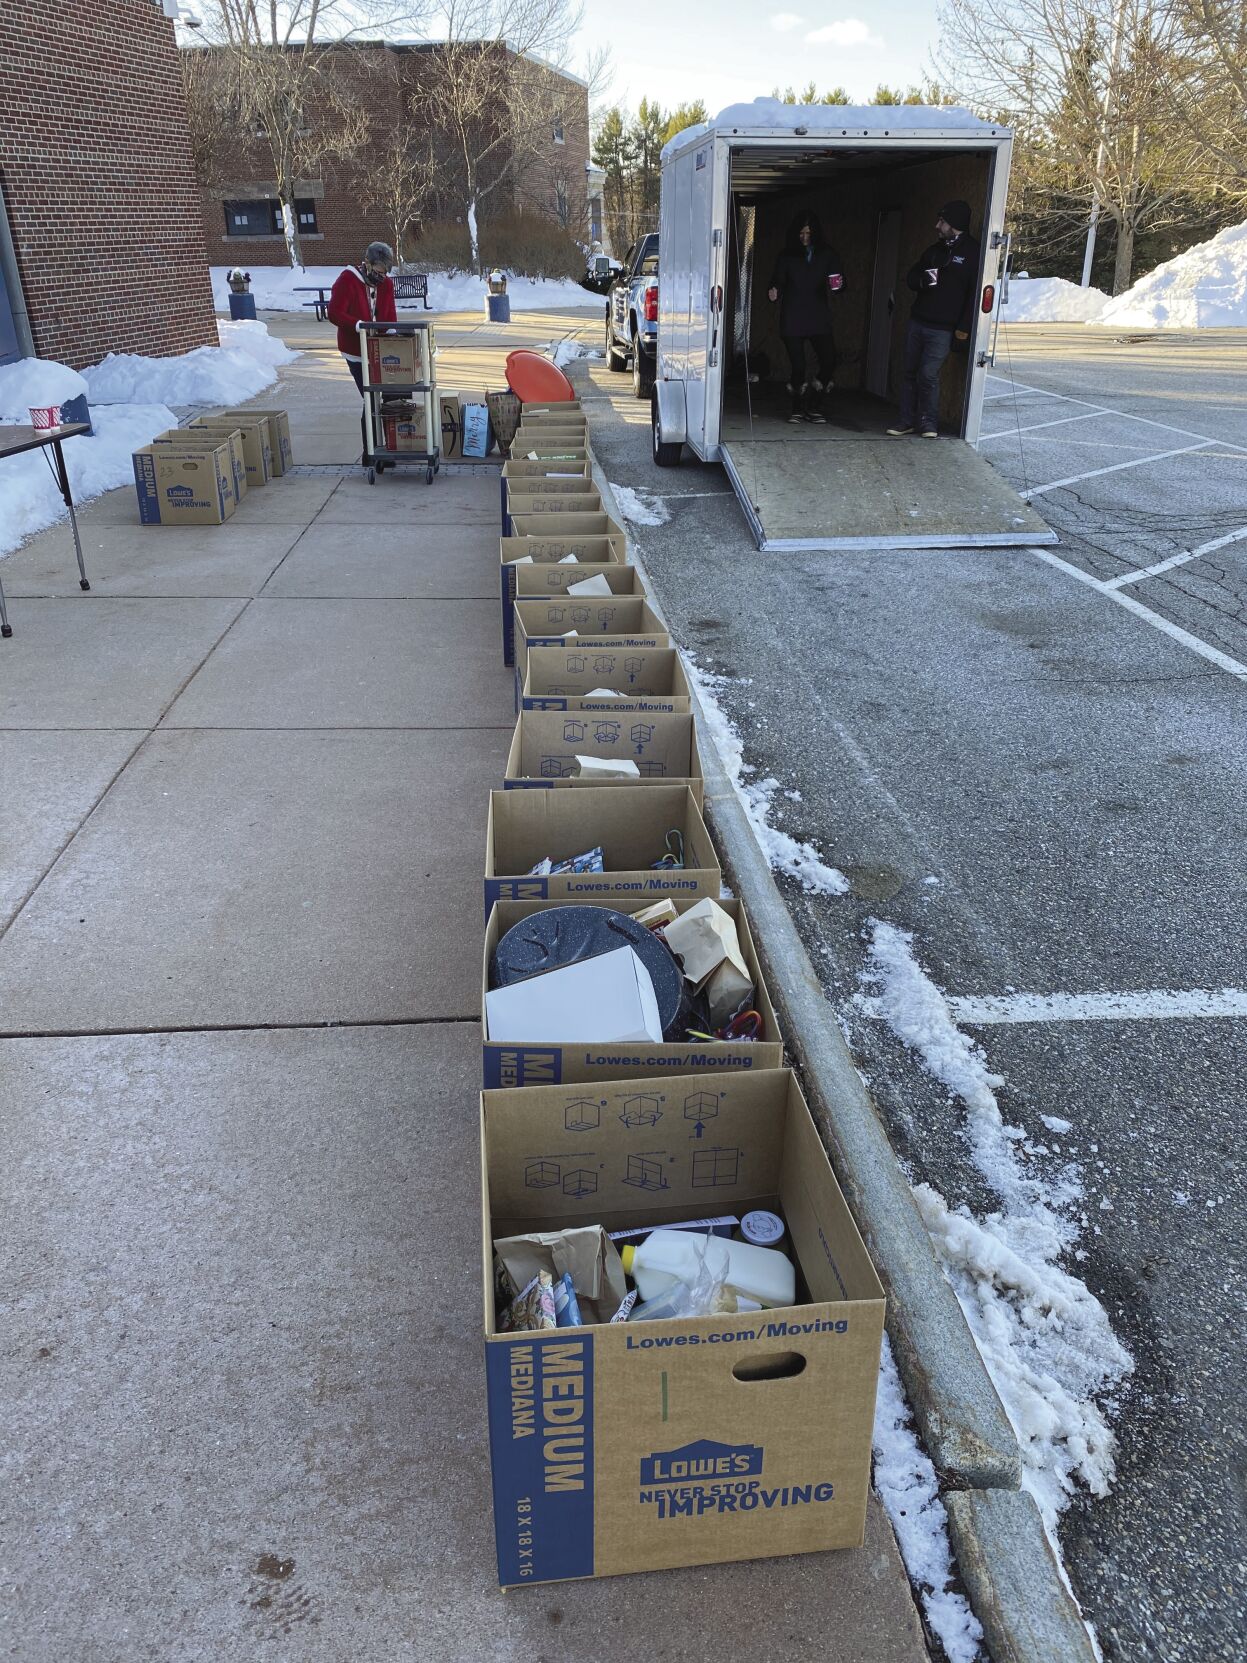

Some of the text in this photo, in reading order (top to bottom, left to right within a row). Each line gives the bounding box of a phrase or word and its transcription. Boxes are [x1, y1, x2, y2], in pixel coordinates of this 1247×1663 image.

[465, 416, 487, 453] Merry
[142, 455, 157, 498] MEDIUM
[576, 639, 656, 648] Lowes.com/Moving
[580, 702, 674, 711] Lowes.com/Moving
[567, 878, 698, 893] Lowes.com/Moving
[585, 1053, 753, 1070] Lowes.com/Moving
[626, 1317, 849, 1350] Lowes.com/Moving
[510, 1345, 536, 1440] MEDIANA
[541, 1342, 585, 1494] MEDIUM
[654, 1452, 751, 1480] LOWE'S
[639, 1481, 760, 1504] NEVER STOP
[658, 1482, 834, 1519] IMPROVING
[517, 1497, 533, 1577] 18 X 18 X 16
